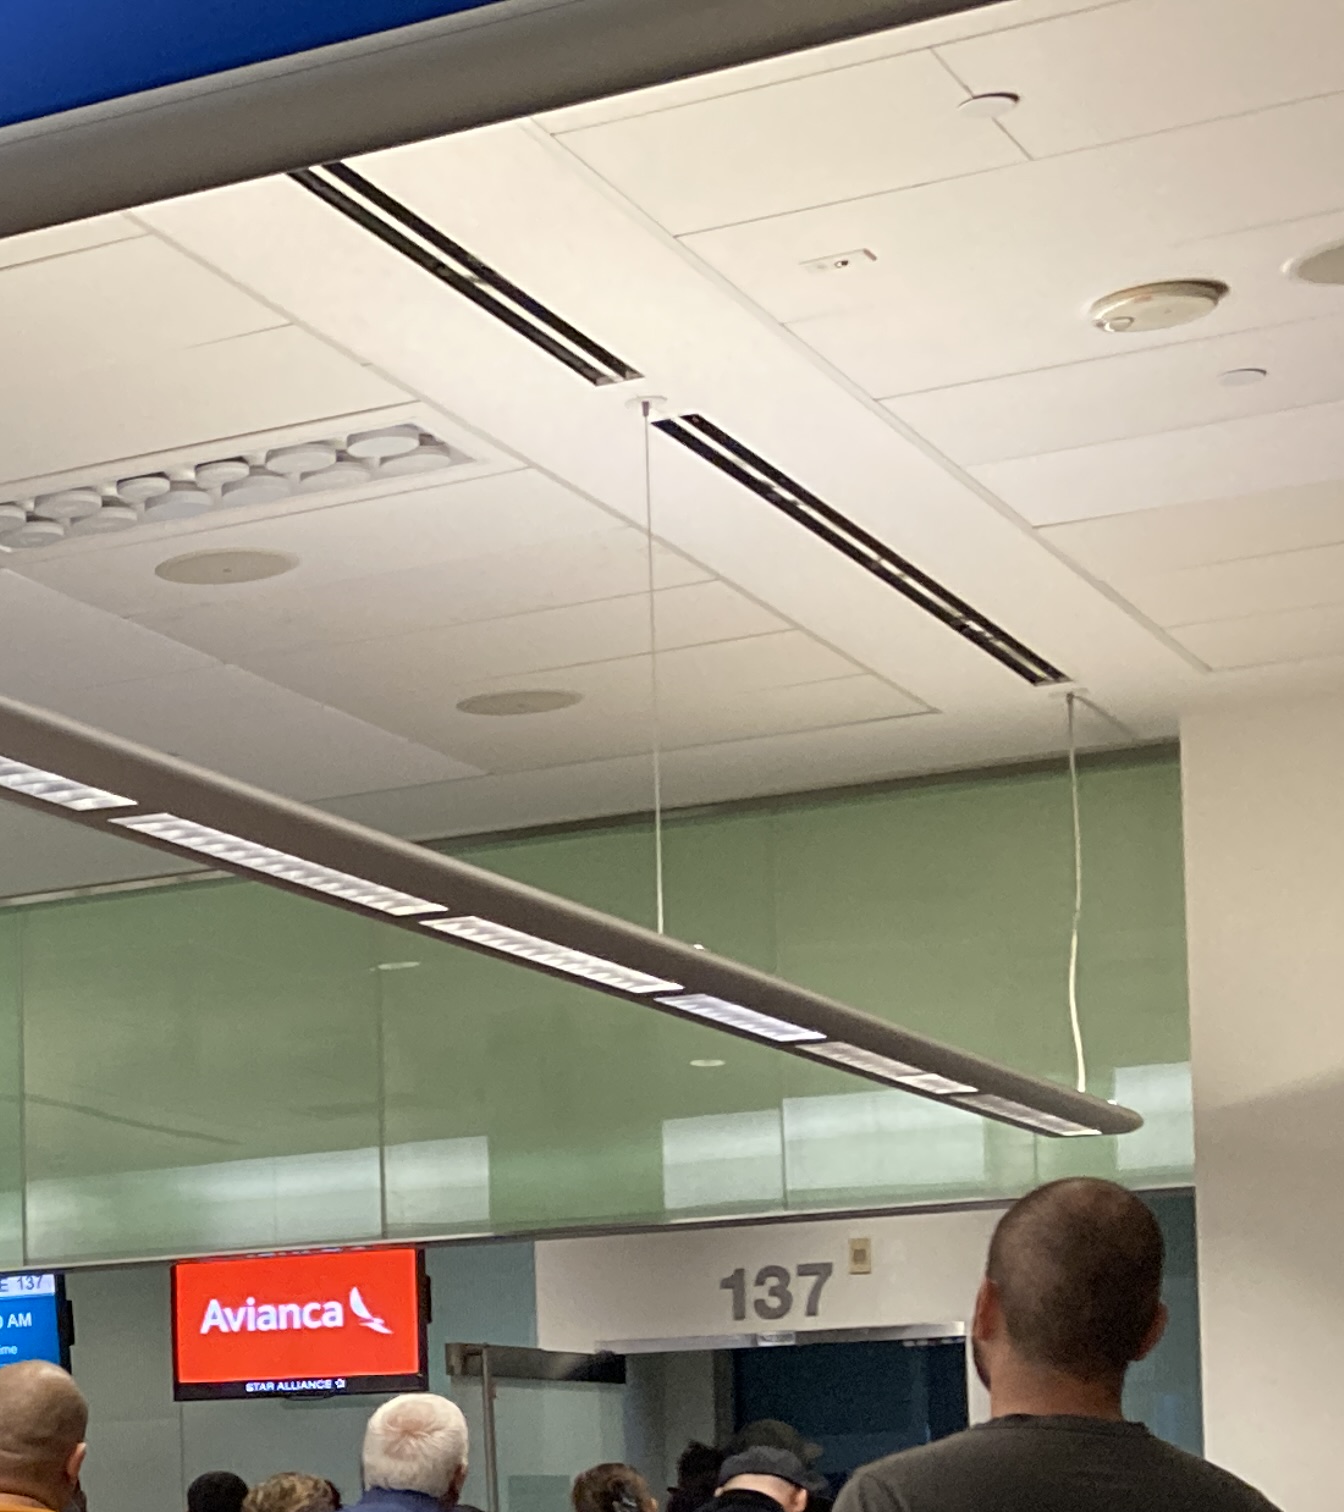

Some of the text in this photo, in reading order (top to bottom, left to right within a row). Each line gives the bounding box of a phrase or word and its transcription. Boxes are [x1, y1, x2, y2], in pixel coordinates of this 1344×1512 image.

[17, 1274, 43, 1291] 137
[720, 1262, 833, 1321] 137
[7, 1312, 33, 1328] AM
[200, 1296, 344, 1334] Avianca
[245, 1379, 332, 1393] STAR ALLIANCE
